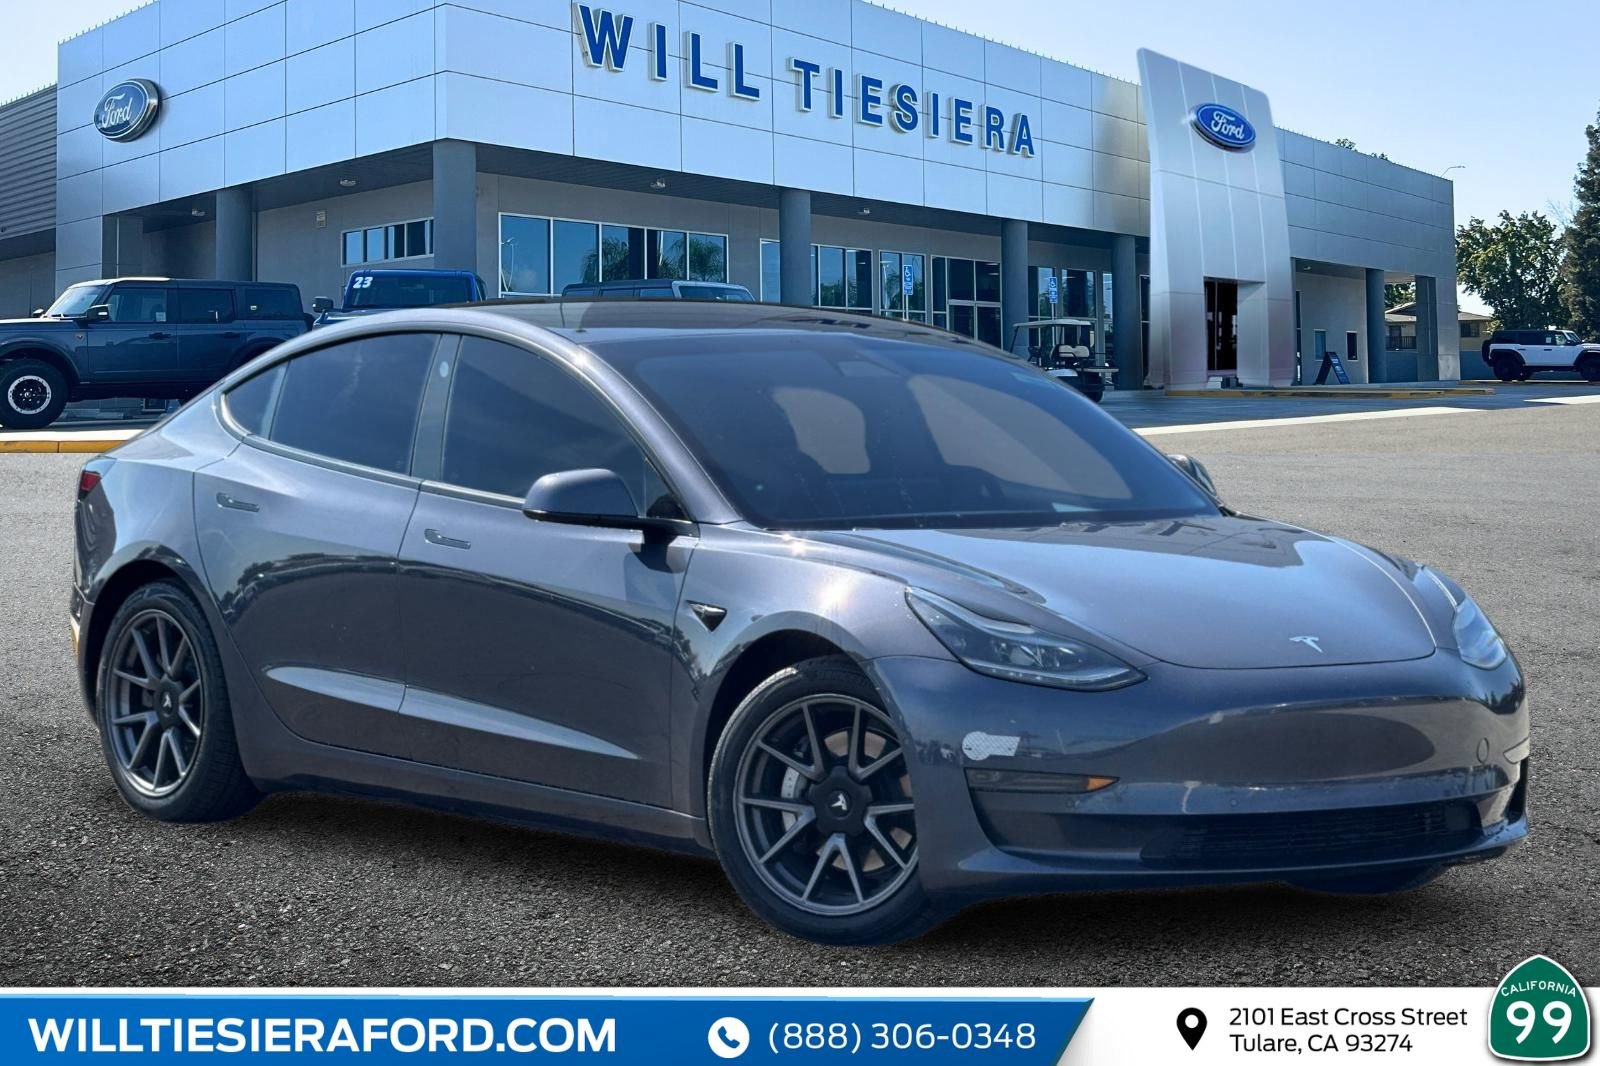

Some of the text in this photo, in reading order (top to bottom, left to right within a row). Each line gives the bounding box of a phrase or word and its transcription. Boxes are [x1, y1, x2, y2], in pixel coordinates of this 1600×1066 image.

[575, 3, 1037, 157] WILL TIESIERA
[101, 93, 133, 128] Ford
[1211, 110, 1245, 140] Ford
[352, 276, 373, 289] 23
